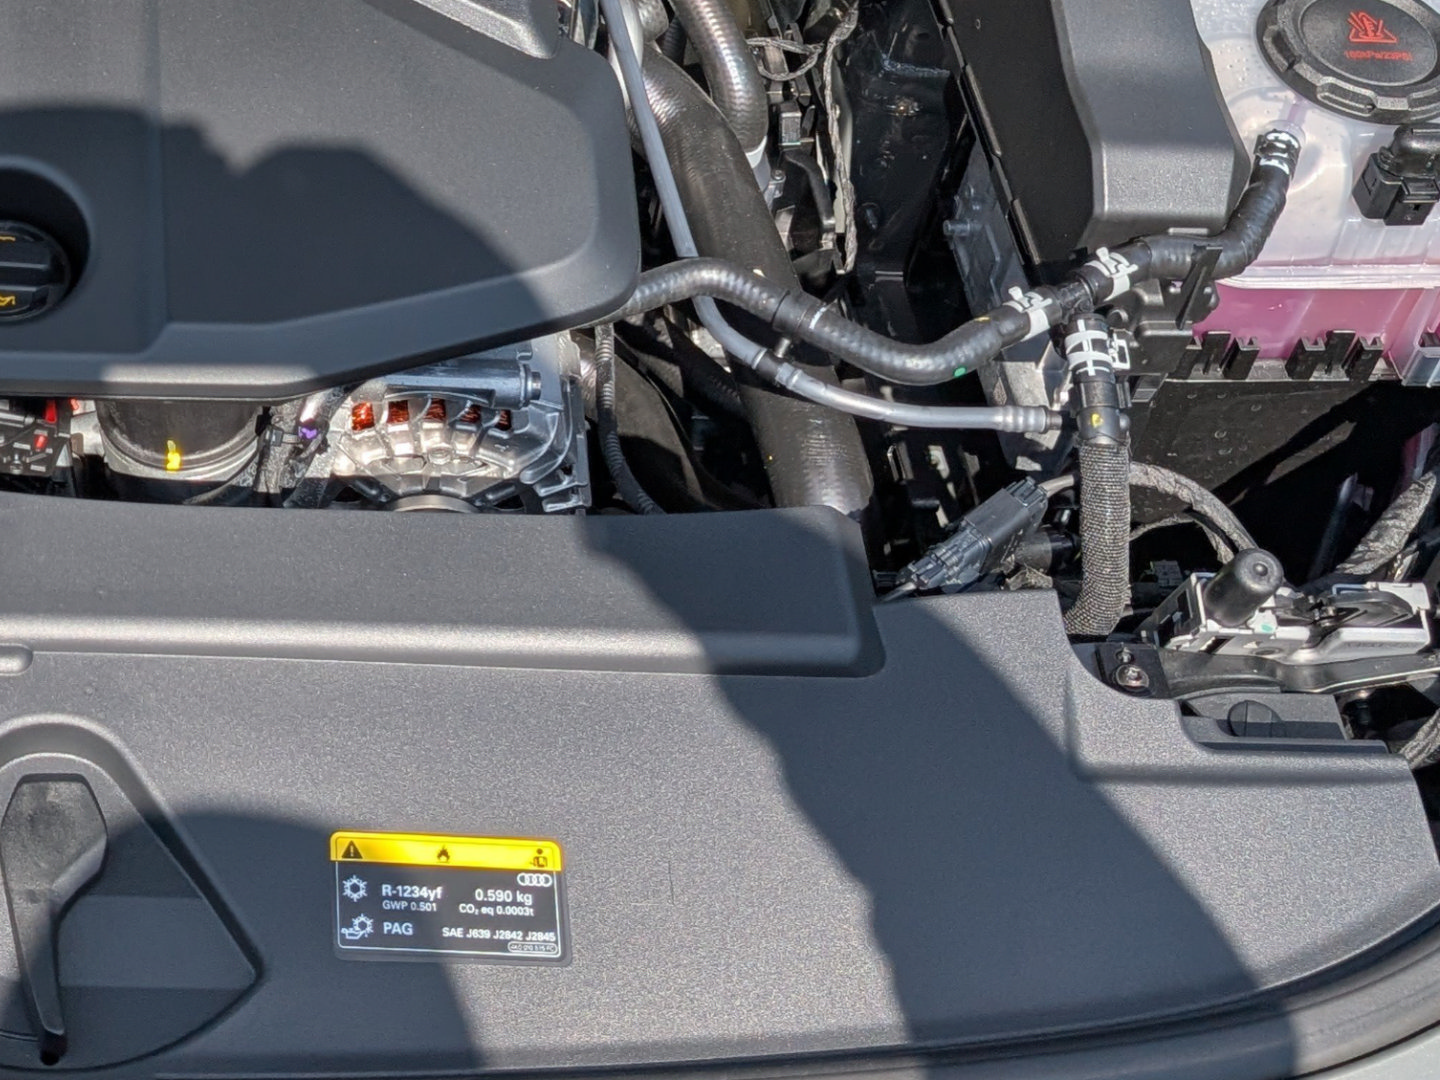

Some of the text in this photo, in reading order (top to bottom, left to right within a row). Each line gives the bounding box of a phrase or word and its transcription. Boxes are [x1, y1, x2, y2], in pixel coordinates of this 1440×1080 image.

[382, 884, 533, 905] R-1234yf 0.590 kg
[382, 900, 408, 911] GWP
[410, 901, 437, 912] 0.501
[481, 907, 494, 917] eq
[496, 905, 534, 917] 0.0003t
[383, 922, 556, 942] PAG SAE J639 J2842 J2845
